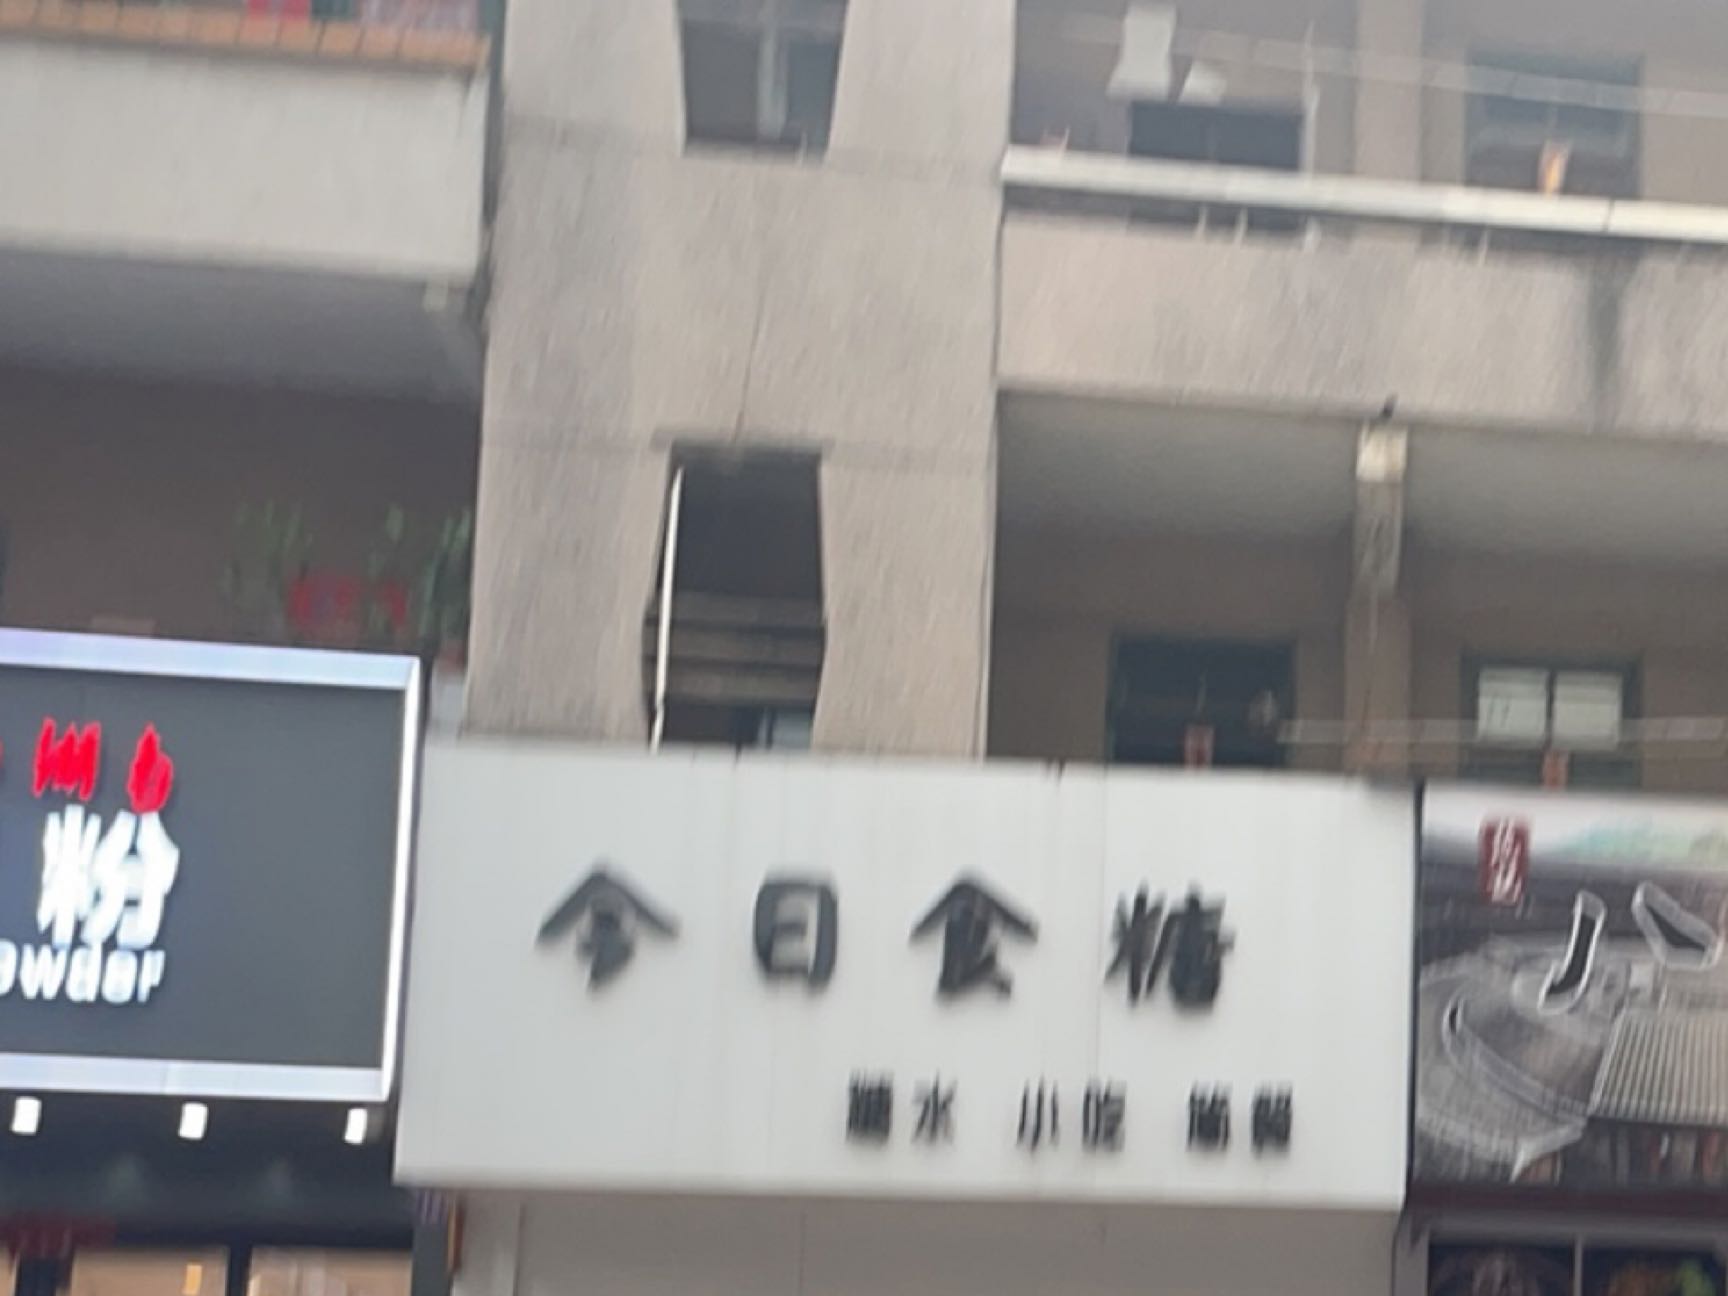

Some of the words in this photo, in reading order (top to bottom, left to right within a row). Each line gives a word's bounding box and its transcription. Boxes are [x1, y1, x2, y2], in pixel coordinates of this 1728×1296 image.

[36, 804, 180, 948] 粉
[534, 860, 1236, 1018] 今日食糖
